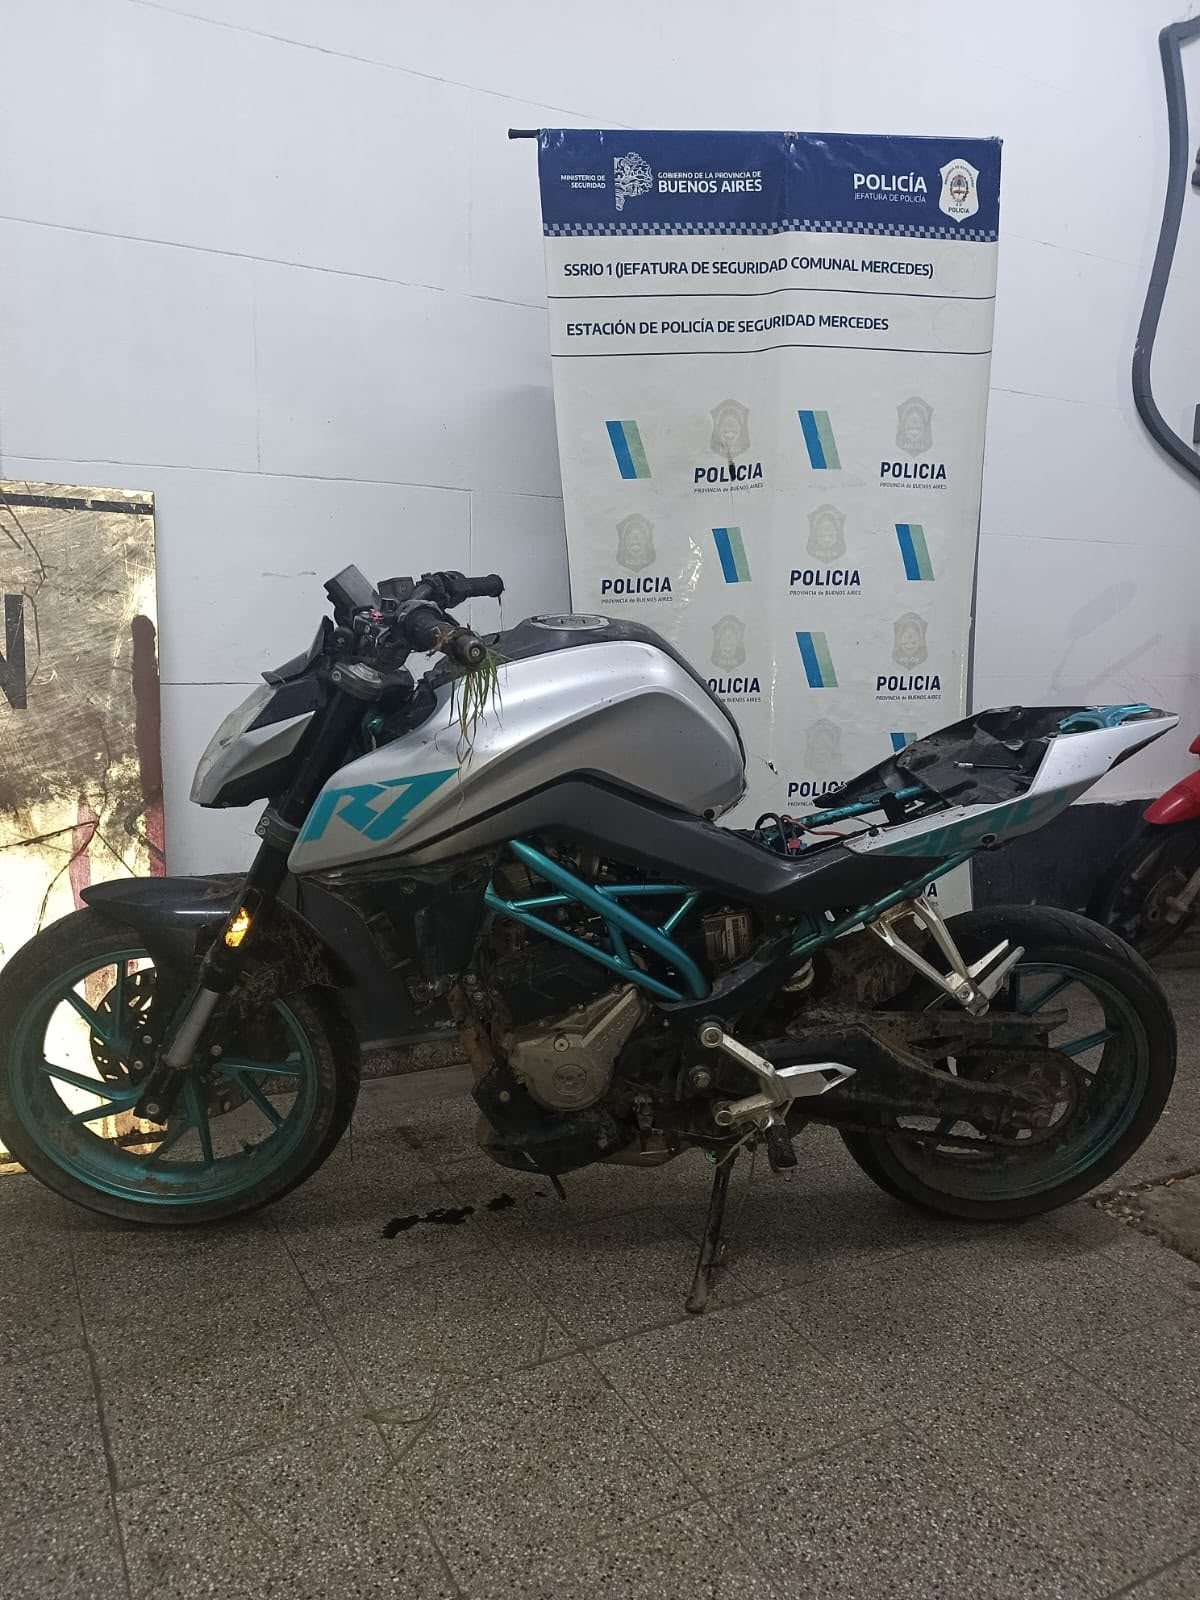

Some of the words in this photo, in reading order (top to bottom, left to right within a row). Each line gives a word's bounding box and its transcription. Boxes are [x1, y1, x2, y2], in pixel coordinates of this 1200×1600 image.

[659, 181, 717, 193] BUENOS
[721, 179, 762, 193] AIRES
[854, 172, 928, 193] POLICÍA
[855, 192, 887, 201] JEFATURA
[889, 194, 899, 202] DE
[900, 194, 926, 203] POLICÍA
[564, 264, 604, 276] SSRIO
[607, 263, 612, 276] 1
[616, 262, 688, 278] (JEFATURA
[692, 262, 710, 274] DE
[712, 258, 788, 274] SEGURIDAD
[791, 257, 858, 272] COMUNAL
[862, 260, 934, 279] MERCEDES)
[567, 320, 636, 336] ESTACIÓN
[640, 322, 658, 334] DE
[662, 318, 714, 334] POLICÍA
[718, 321, 735, 333] DE
[738, 314, 815, 332] SEGURIDAD
[819, 315, 889, 330] MERCEDES
[694, 463, 762, 483] POLICIA
[880, 462, 946, 479] POLICIA
[602, 577, 672, 594] POLICIA
[790, 570, 860, 586] POLICIA
[708, 677, 760, 693] OLICIA
[876, 676, 941, 691] POLICIA
